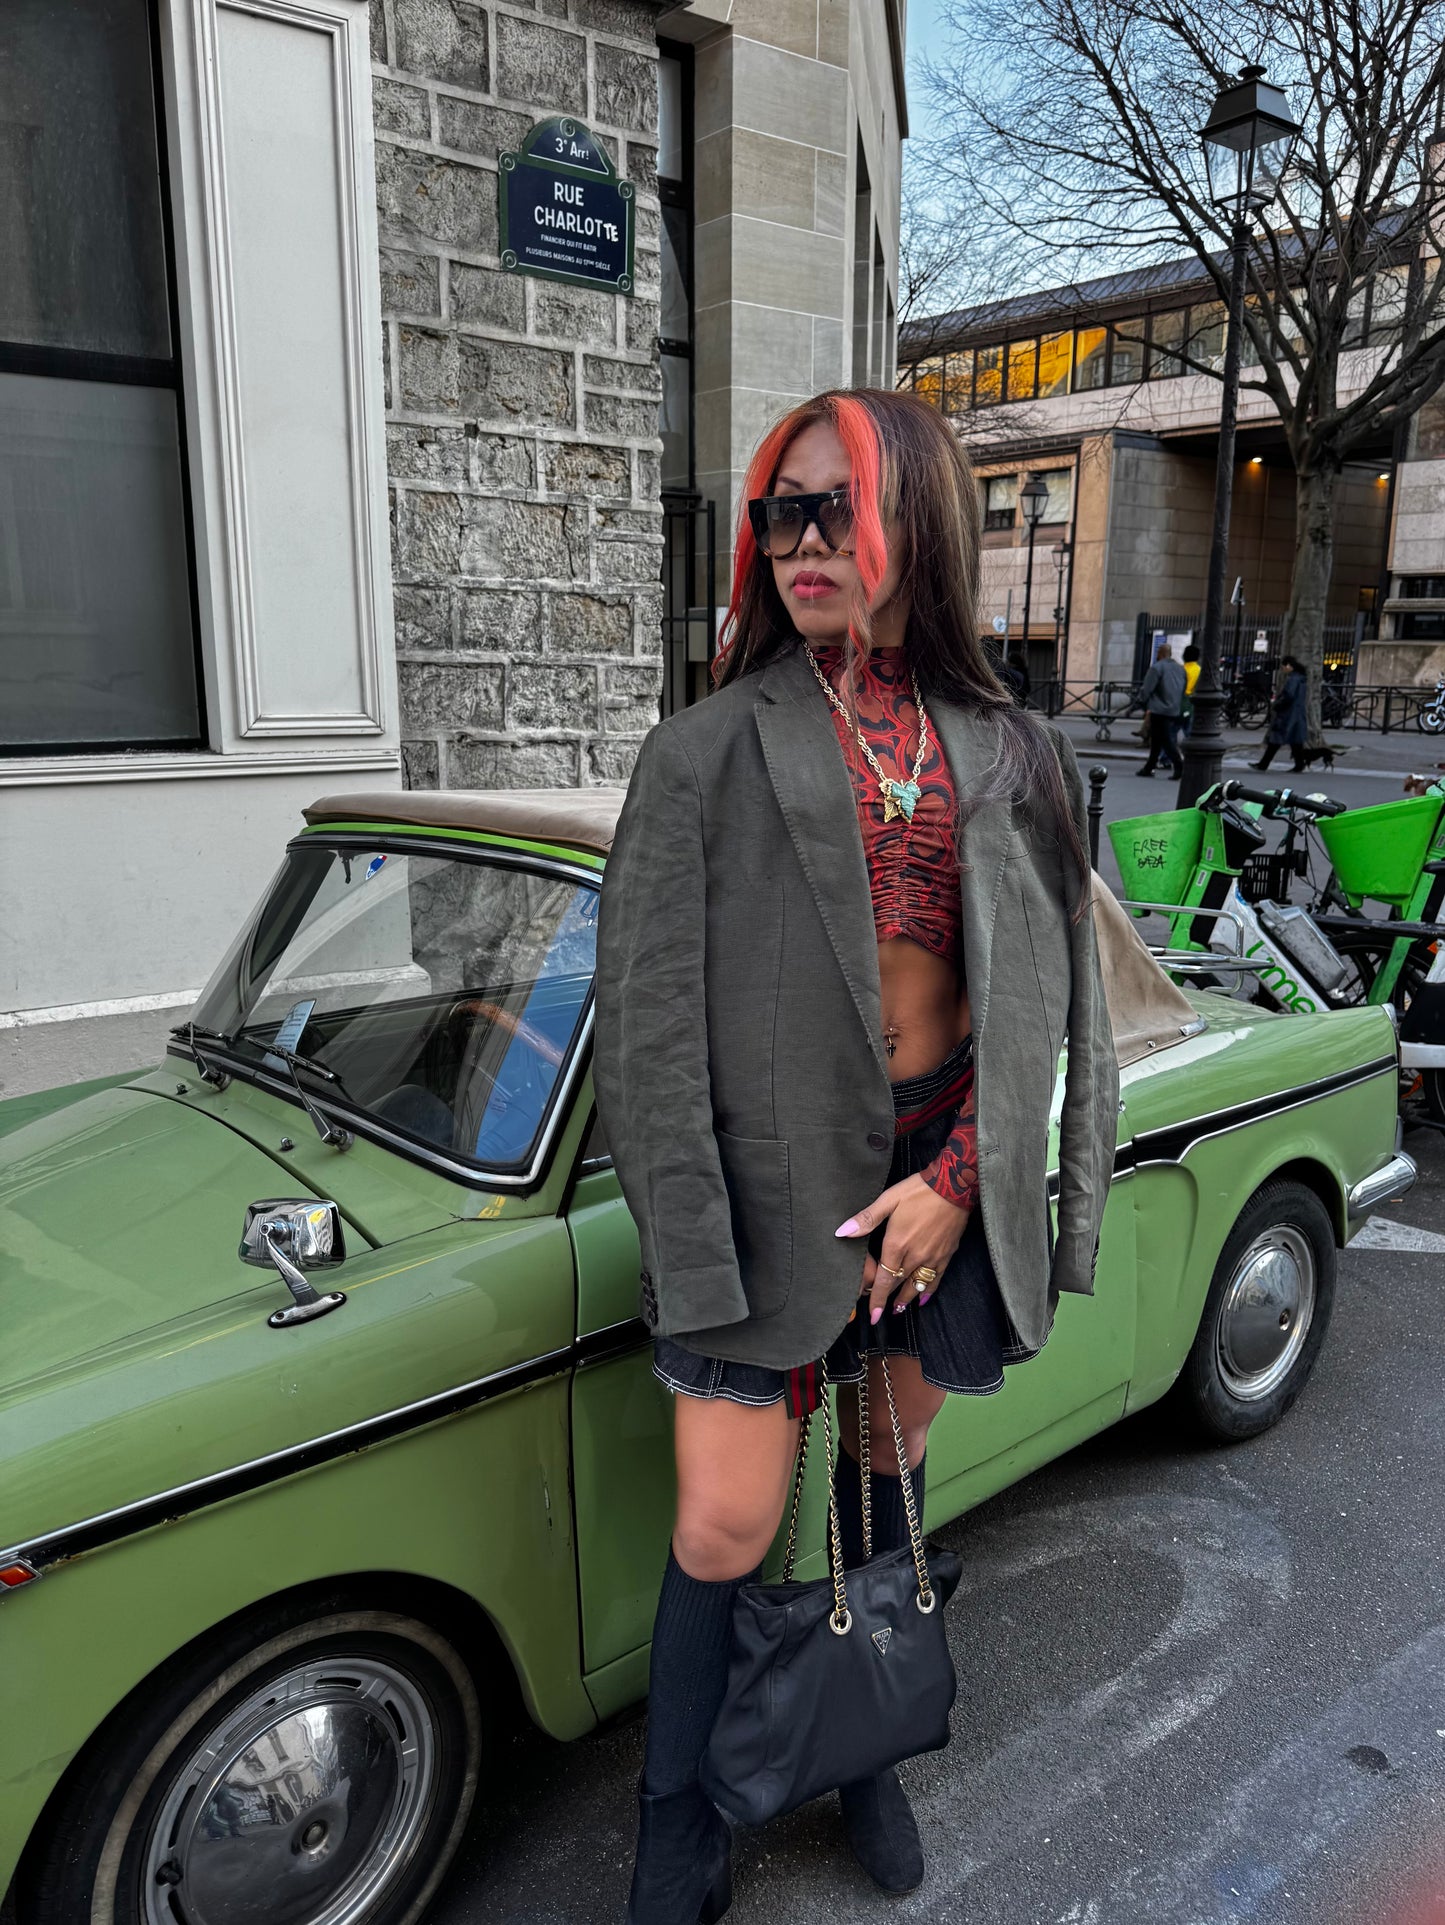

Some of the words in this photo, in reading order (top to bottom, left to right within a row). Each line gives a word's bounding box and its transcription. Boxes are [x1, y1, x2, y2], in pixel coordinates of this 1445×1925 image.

[554, 181, 584, 207] RUE
[534, 205, 619, 242] CHARLOTTE
[540, 233, 566, 246] FINANCIER
[566, 239, 575, 248] QUI
[575, 241, 583, 249] FIT
[525, 246, 553, 259] PLUSIEURS
[553, 252, 575, 263] MAISONS
[575, 257, 583, 265] AU
[1133, 838, 1168, 859] FREE
